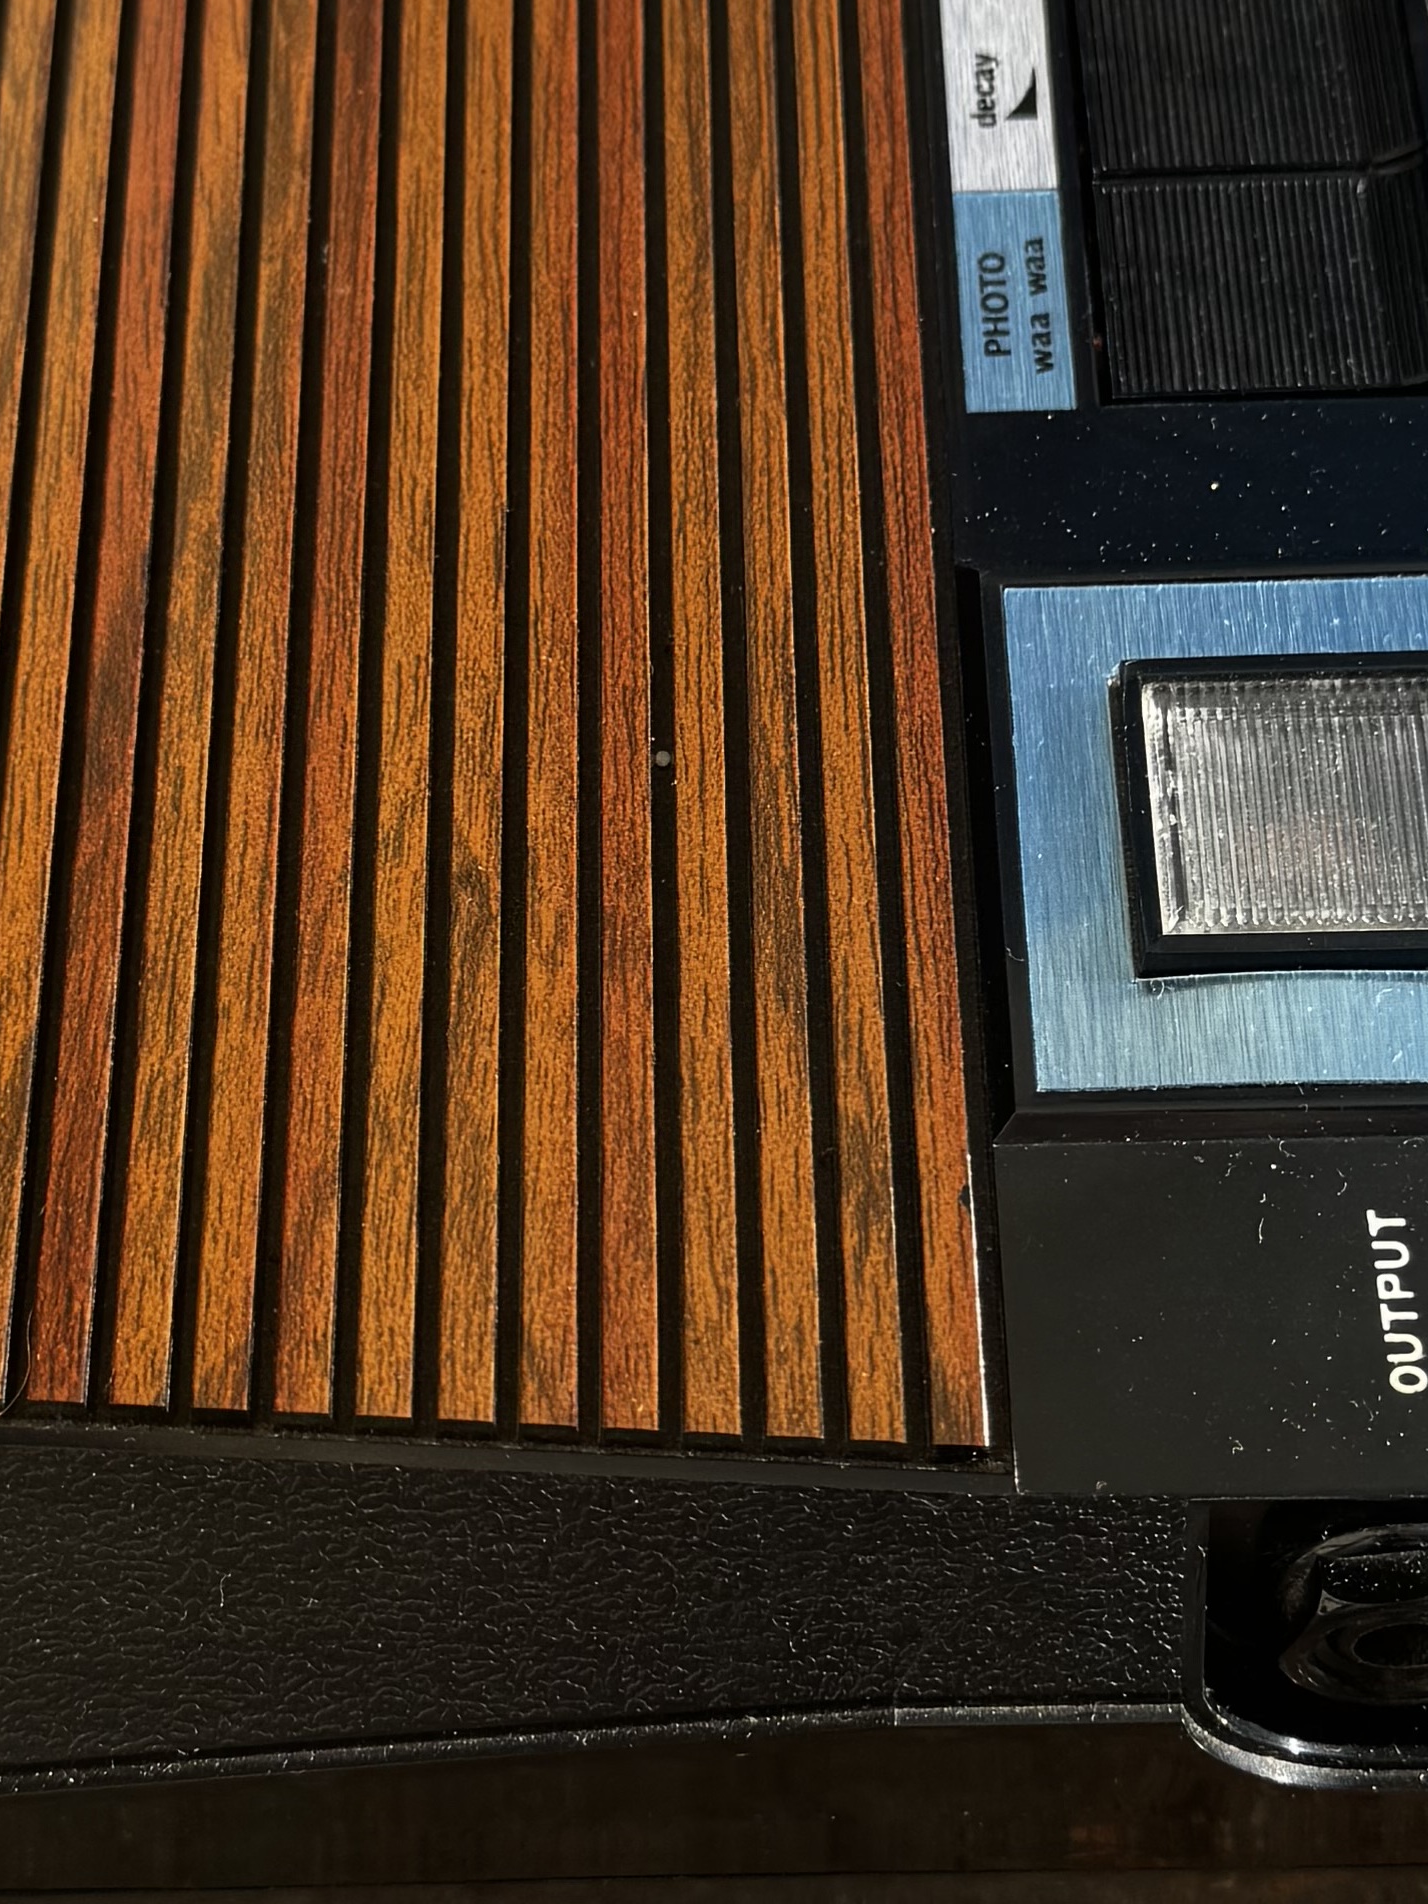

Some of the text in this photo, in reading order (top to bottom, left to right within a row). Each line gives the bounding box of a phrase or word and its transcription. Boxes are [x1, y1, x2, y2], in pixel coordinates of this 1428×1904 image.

[969, 53, 1000, 129] decay
[977, 250, 1013, 358] PHOTO
[1025, 235, 1055, 375] waa waa
